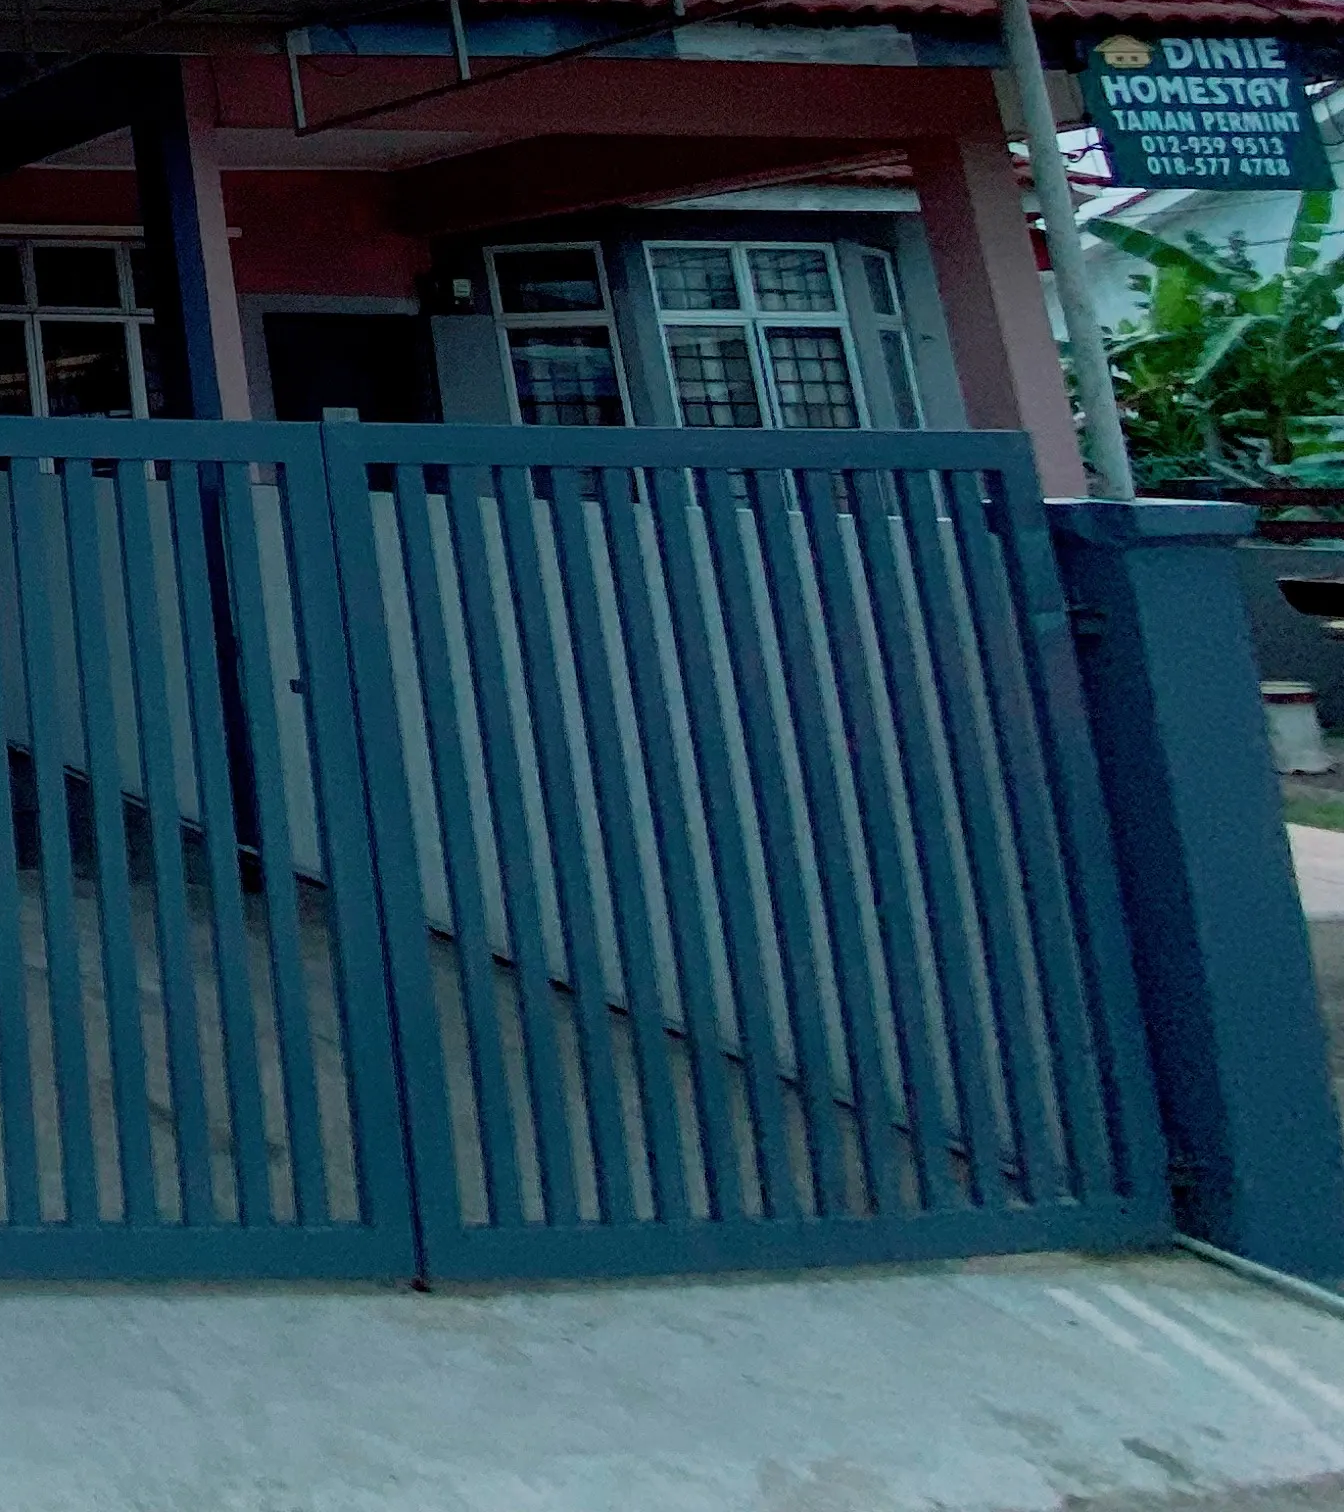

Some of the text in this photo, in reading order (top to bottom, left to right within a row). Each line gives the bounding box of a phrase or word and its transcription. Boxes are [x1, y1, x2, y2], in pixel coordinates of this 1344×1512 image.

[1161, 38, 1286, 69] DINIE
[1101, 75, 1289, 107] HOMESTAY
[1112, 110, 1196, 131] TAMAN
